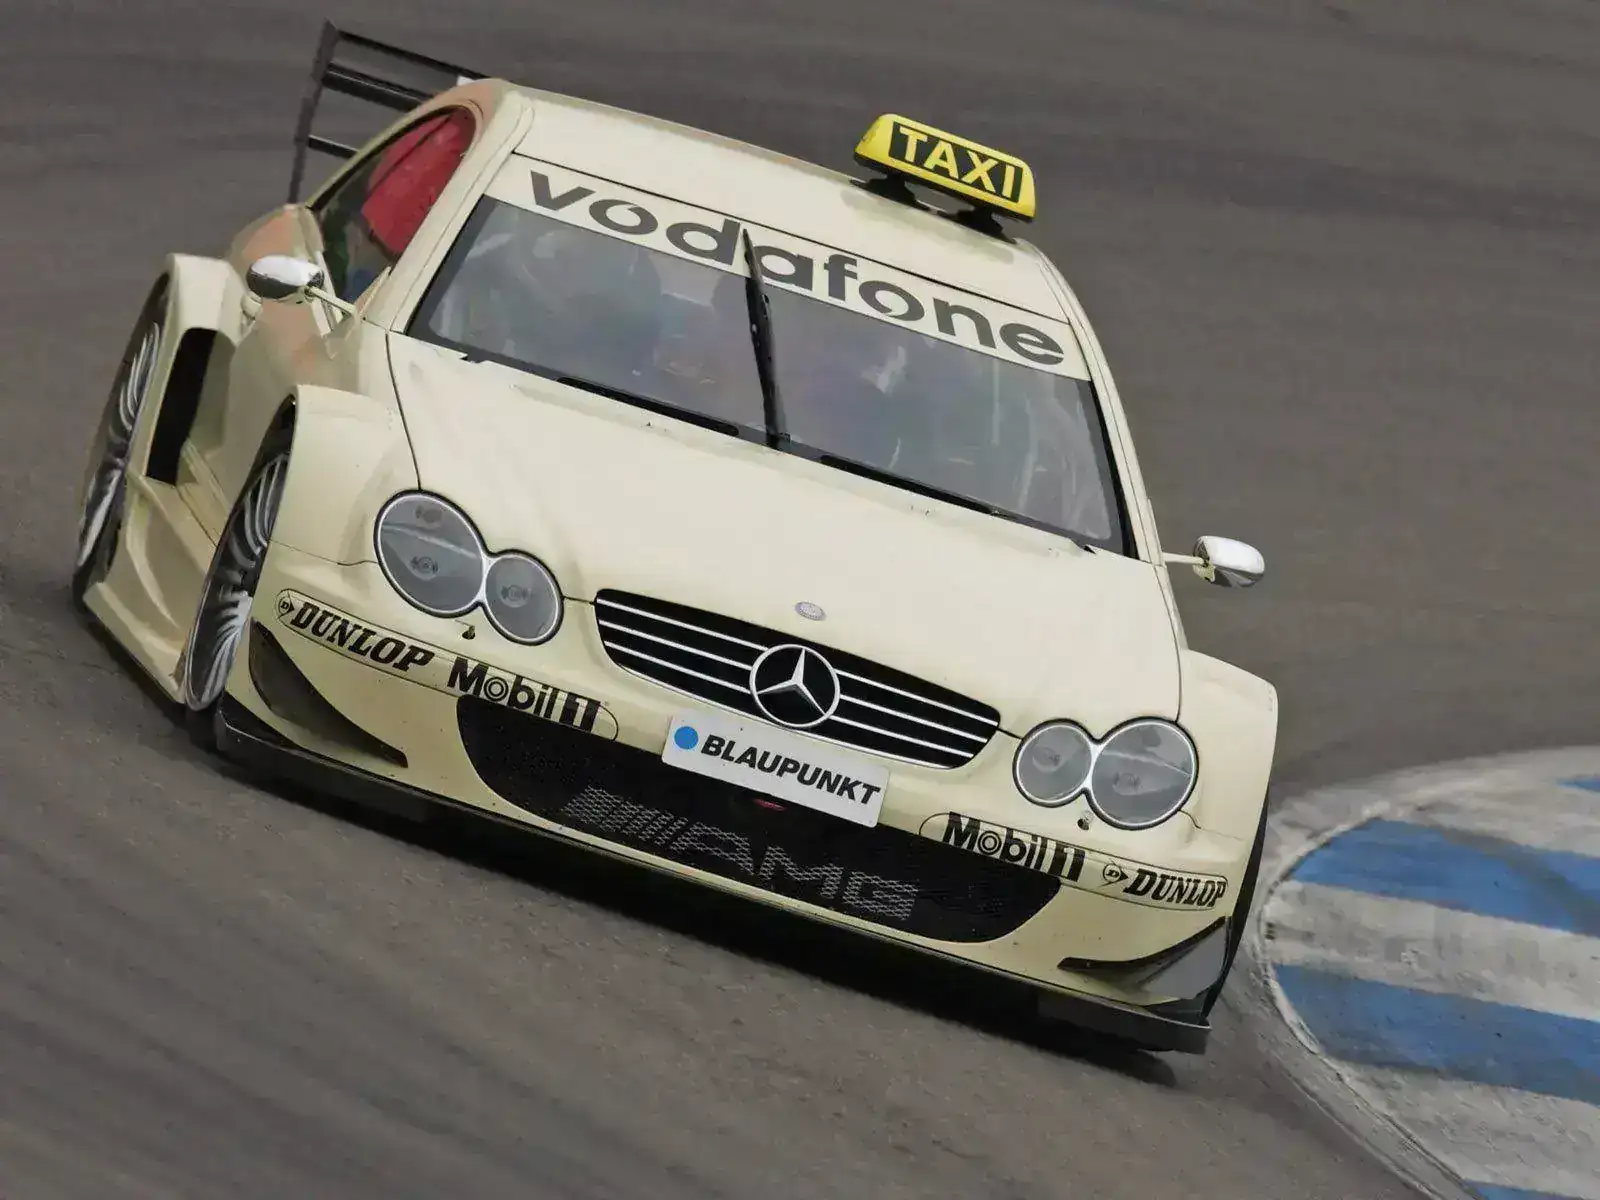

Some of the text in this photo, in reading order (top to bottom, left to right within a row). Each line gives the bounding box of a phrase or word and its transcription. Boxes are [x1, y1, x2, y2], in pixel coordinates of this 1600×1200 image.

[899, 126, 1015, 198] TAXI
[530, 170, 1065, 365] vodafone
[290, 602, 434, 671] DUNLOP
[447, 656, 560, 718] Mobil
[701, 734, 881, 804] BLAUPUNKT
[670, 822, 918, 920] AMG
[942, 811, 1049, 870] Mobil
[1123, 868, 1227, 907] DUNLOP
